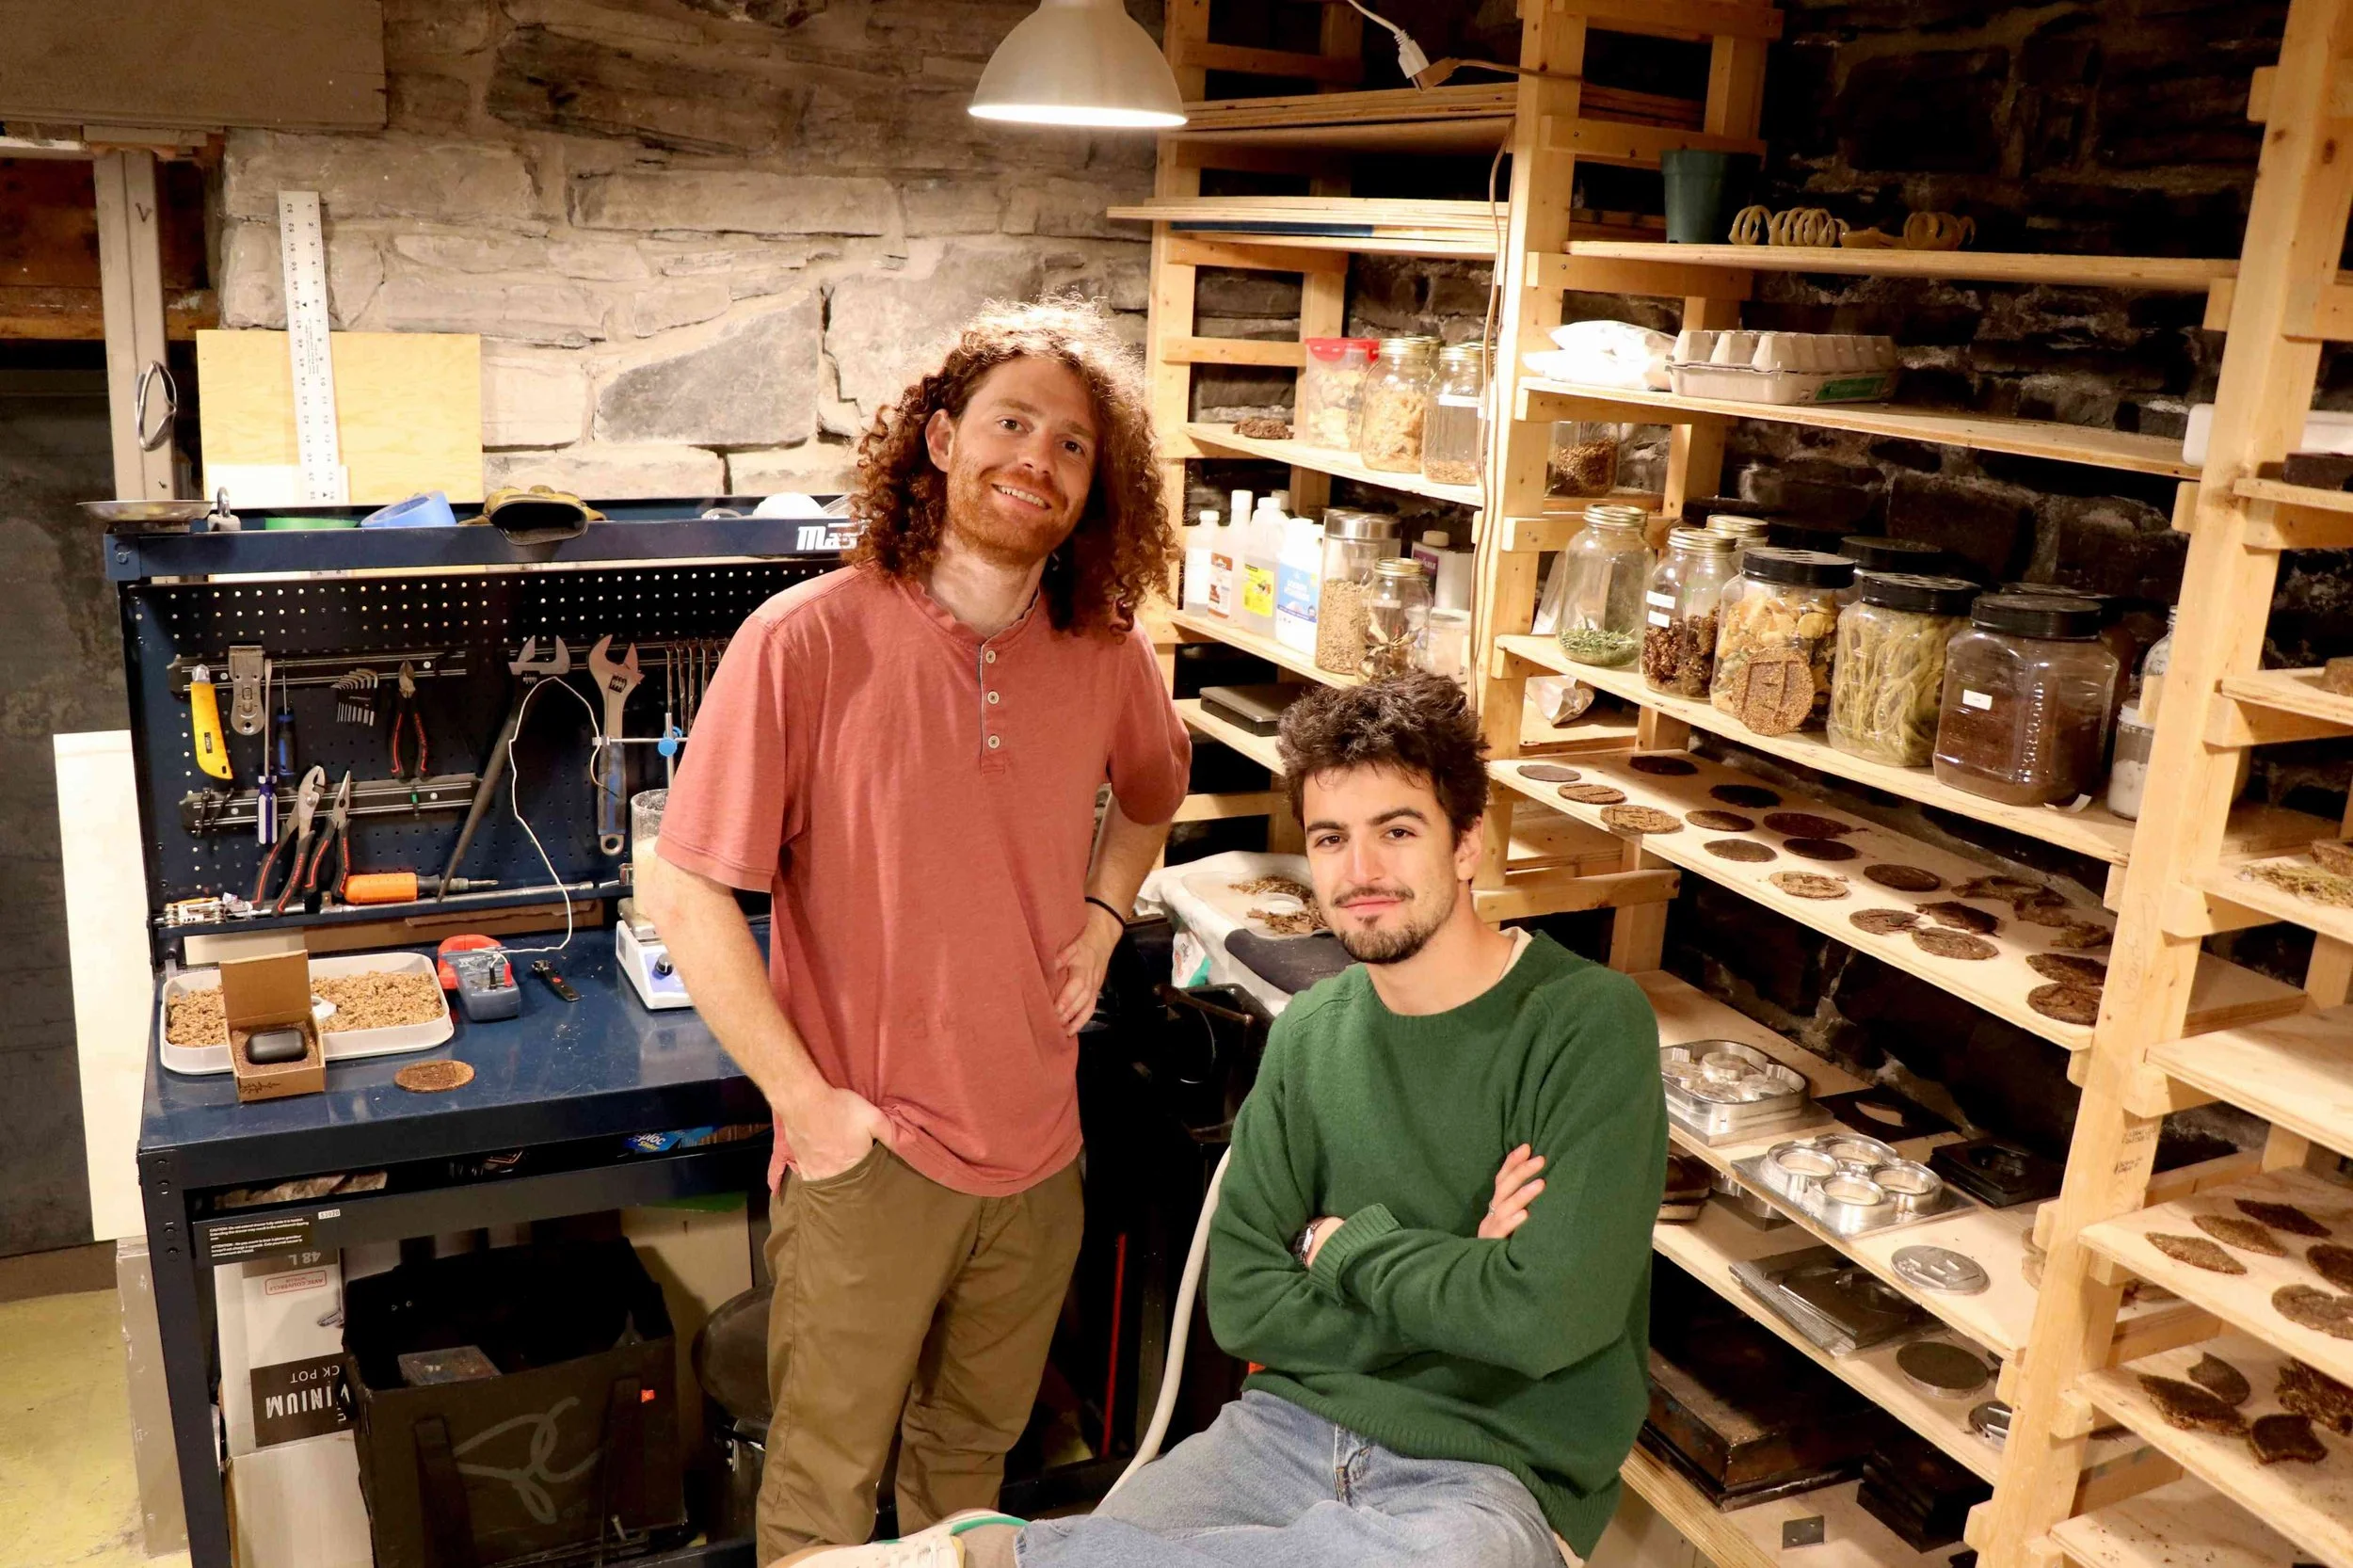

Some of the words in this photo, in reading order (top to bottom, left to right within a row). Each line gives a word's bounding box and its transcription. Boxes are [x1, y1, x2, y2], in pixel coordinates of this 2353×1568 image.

[288, 1254, 297, 1265] L
[302, 1251, 321, 1264] 48
[290, 1369, 317, 1384] POT
